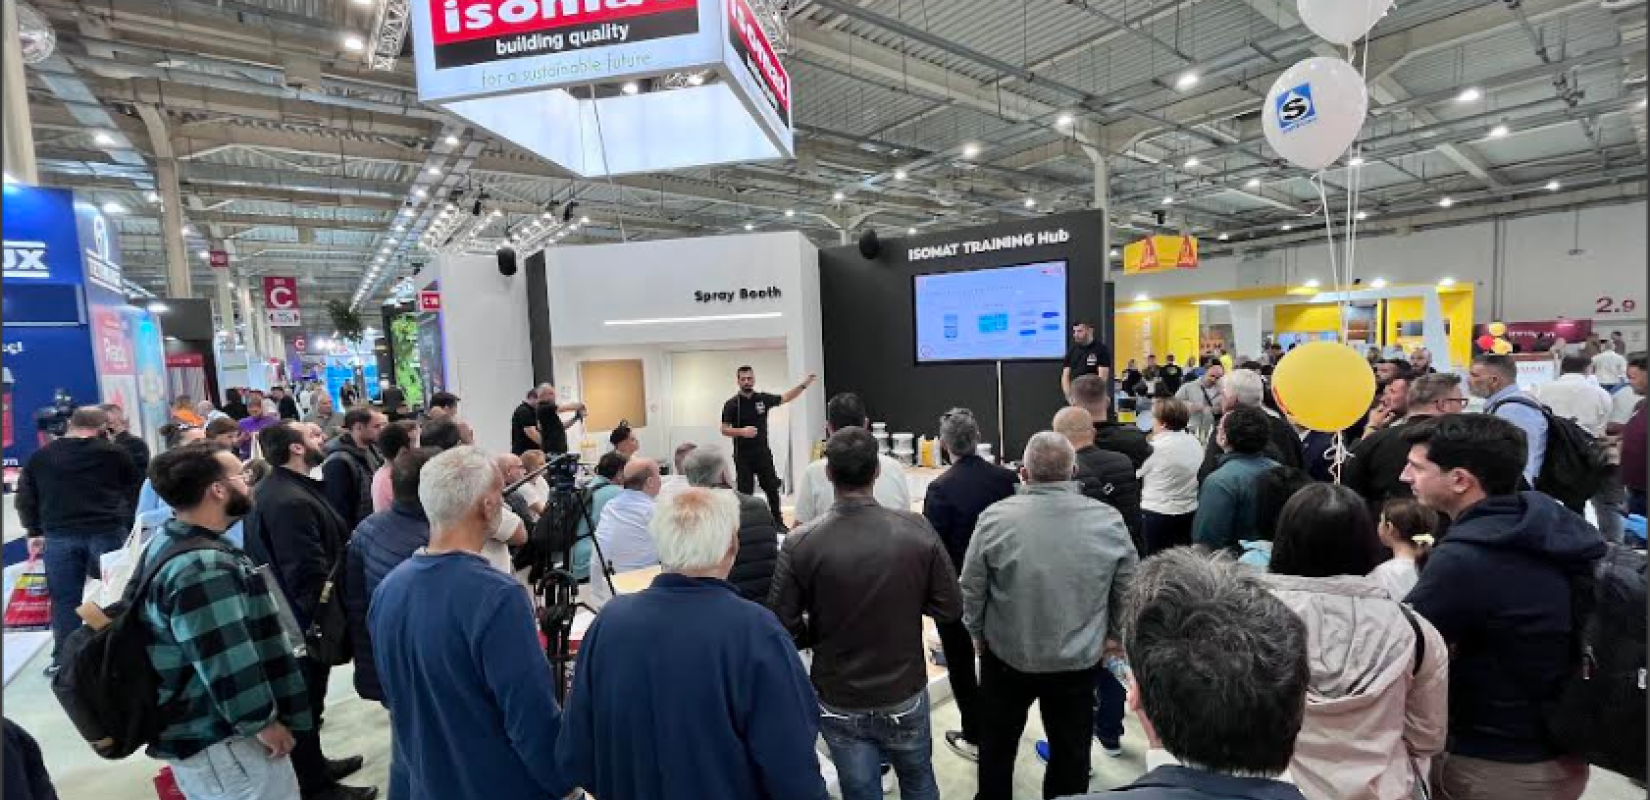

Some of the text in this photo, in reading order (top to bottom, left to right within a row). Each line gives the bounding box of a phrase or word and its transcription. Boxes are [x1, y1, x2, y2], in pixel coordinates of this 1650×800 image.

[444, 0, 662, 33] isom
[496, 24, 629, 55] building quality
[482, 53, 652, 88] for a sustainable future
[1282, 97, 1307, 120] S
[908, 228, 1069, 261] ISOMAT TRAINING Hub
[270, 287, 293, 307] C
[694, 286, 782, 303] Spray Booth
[1595, 297, 1636, 313] 2.9
